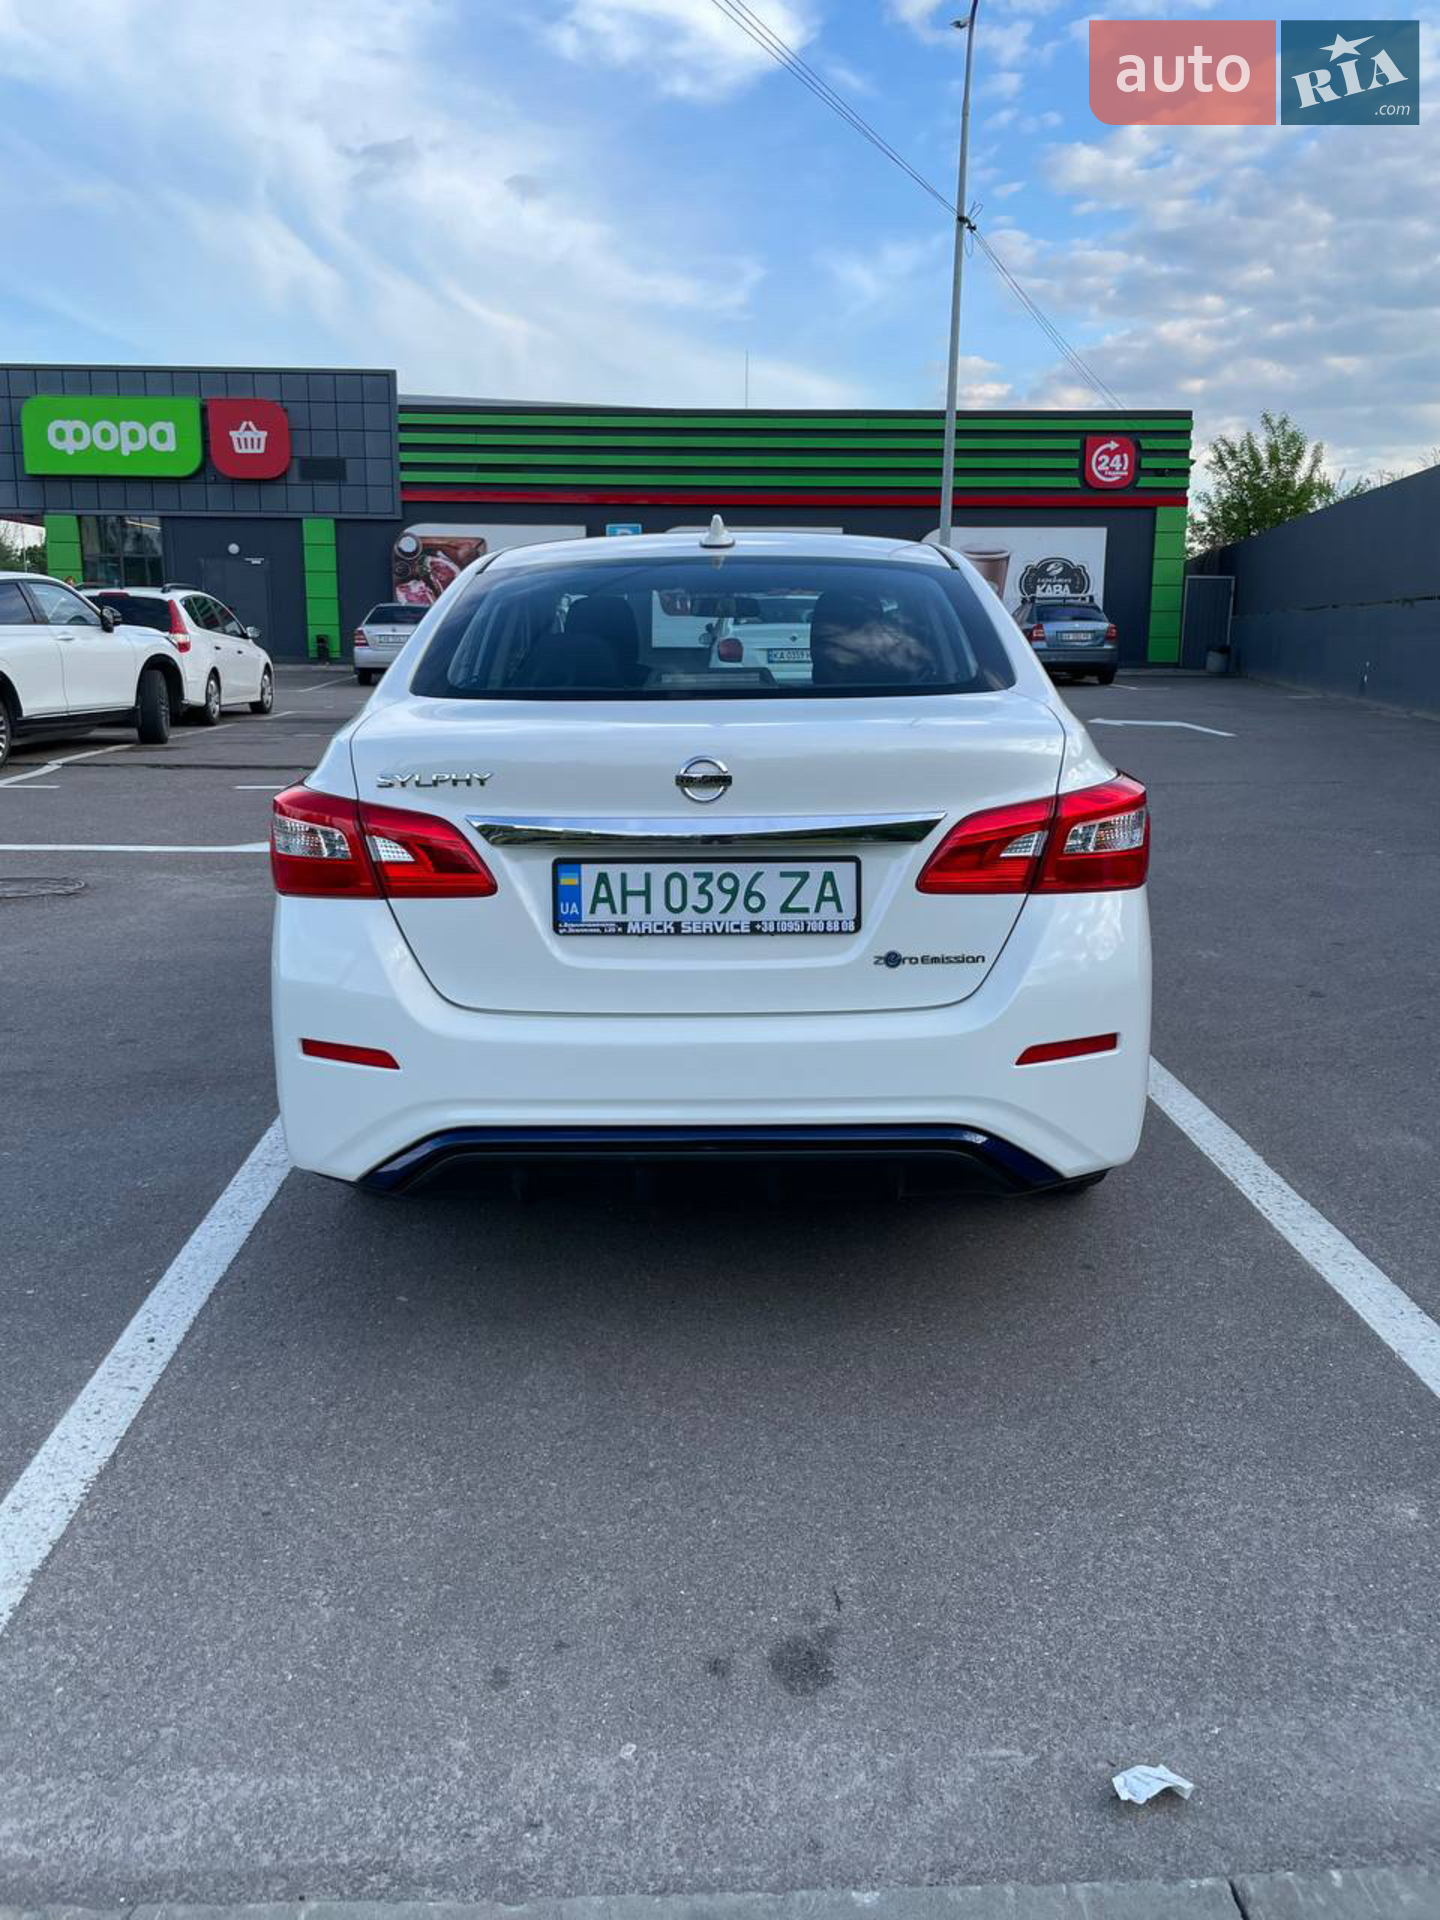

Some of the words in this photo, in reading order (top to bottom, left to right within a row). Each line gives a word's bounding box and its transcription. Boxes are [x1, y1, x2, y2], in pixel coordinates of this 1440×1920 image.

[376, 772, 494, 789] SYLPHY
[588, 871, 651, 915] AH
[664, 870, 767, 915] 0396
[779, 870, 844, 914] ZA
[560, 903, 579, 915] UA
[680, 921, 751, 933] SERVICE
[921, 954, 985, 965] Emission
